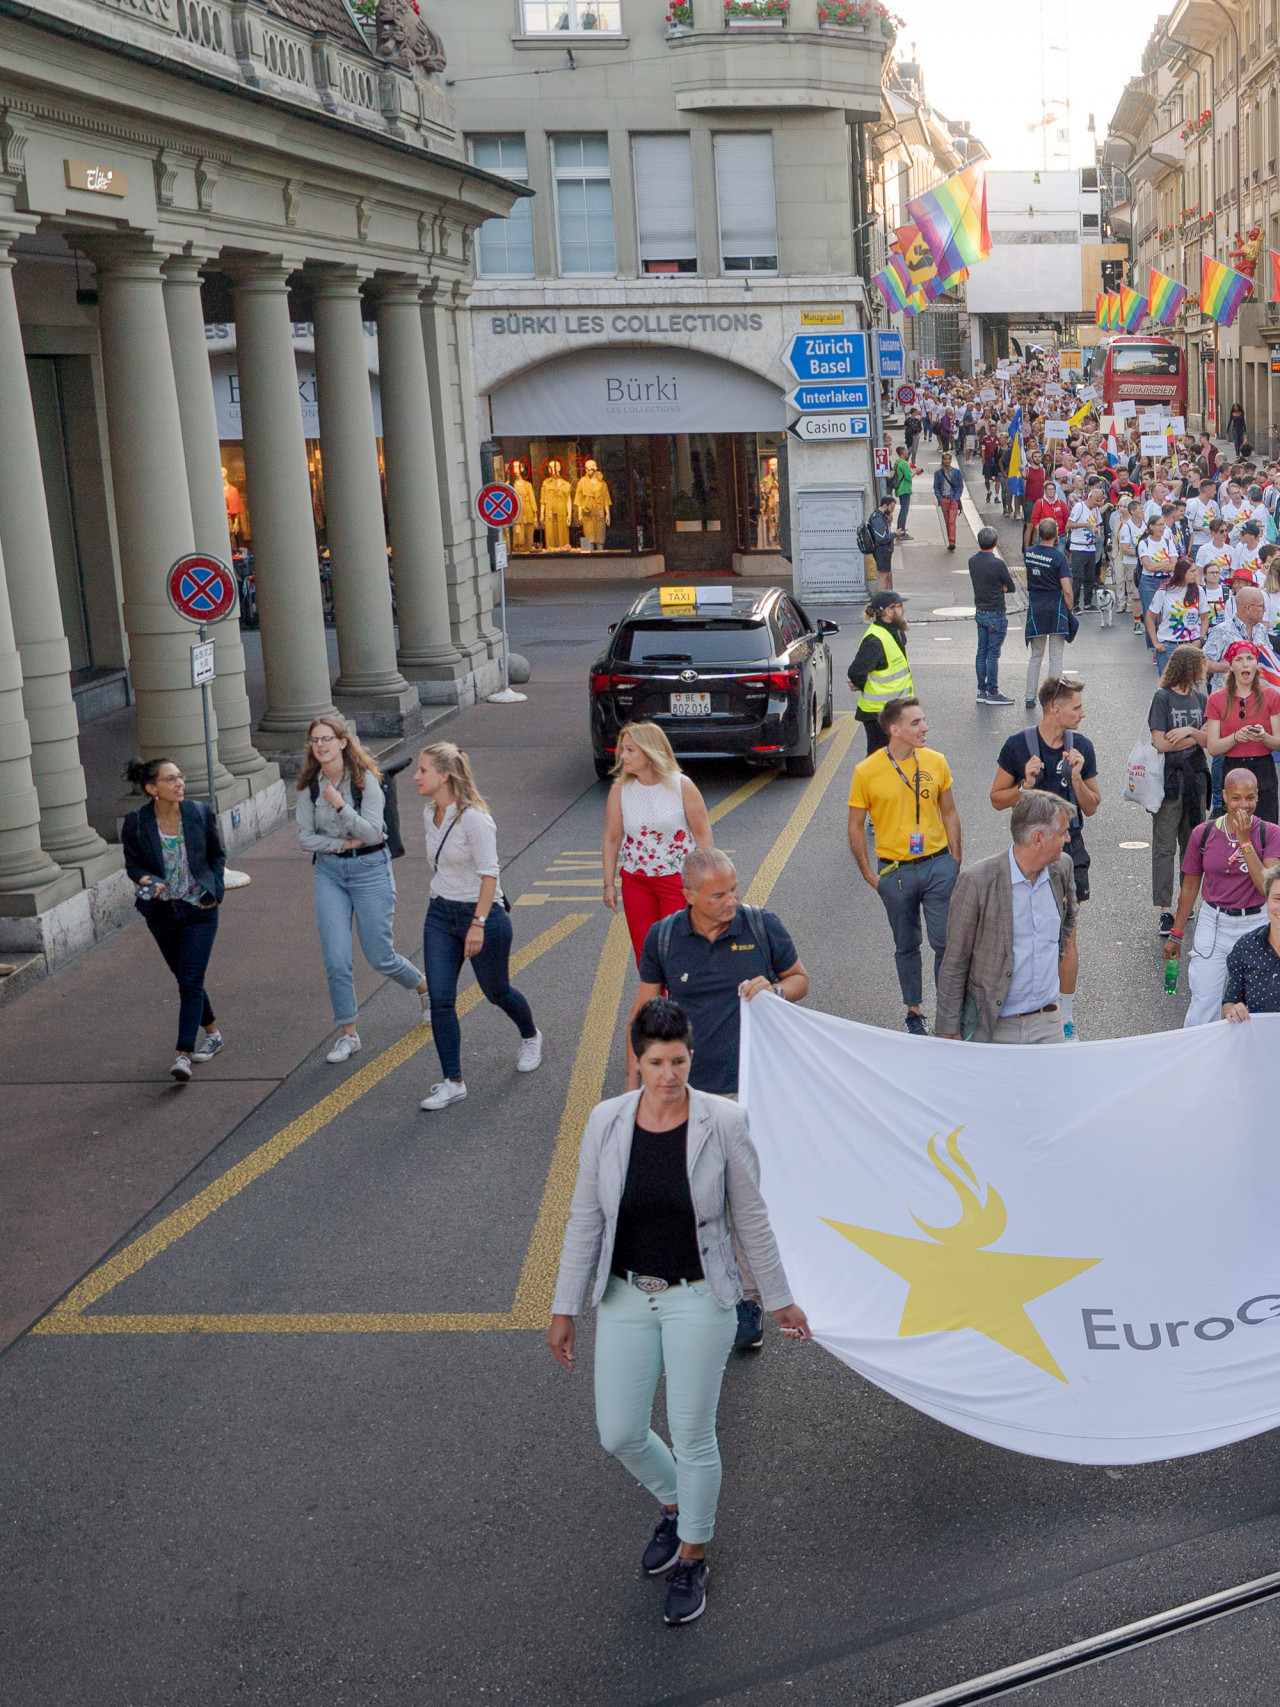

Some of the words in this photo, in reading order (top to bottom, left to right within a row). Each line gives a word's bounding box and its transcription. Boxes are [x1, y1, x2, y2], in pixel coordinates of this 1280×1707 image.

[491, 313, 557, 335] BÜRKI
[564, 315, 605, 334] LES
[611, 313, 764, 333] COLLECTIONS
[804, 338, 854, 356] Zürich
[810, 357, 851, 375] Basel
[605, 375, 679, 402] Bürki
[802, 389, 864, 405] Interlaken
[606, 406, 622, 414] LES
[623, 405, 681, 414] COLLECTIONS
[806, 420, 847, 434] Casino
[667, 593, 690, 601] TAXI
[685, 694, 695, 702] BE
